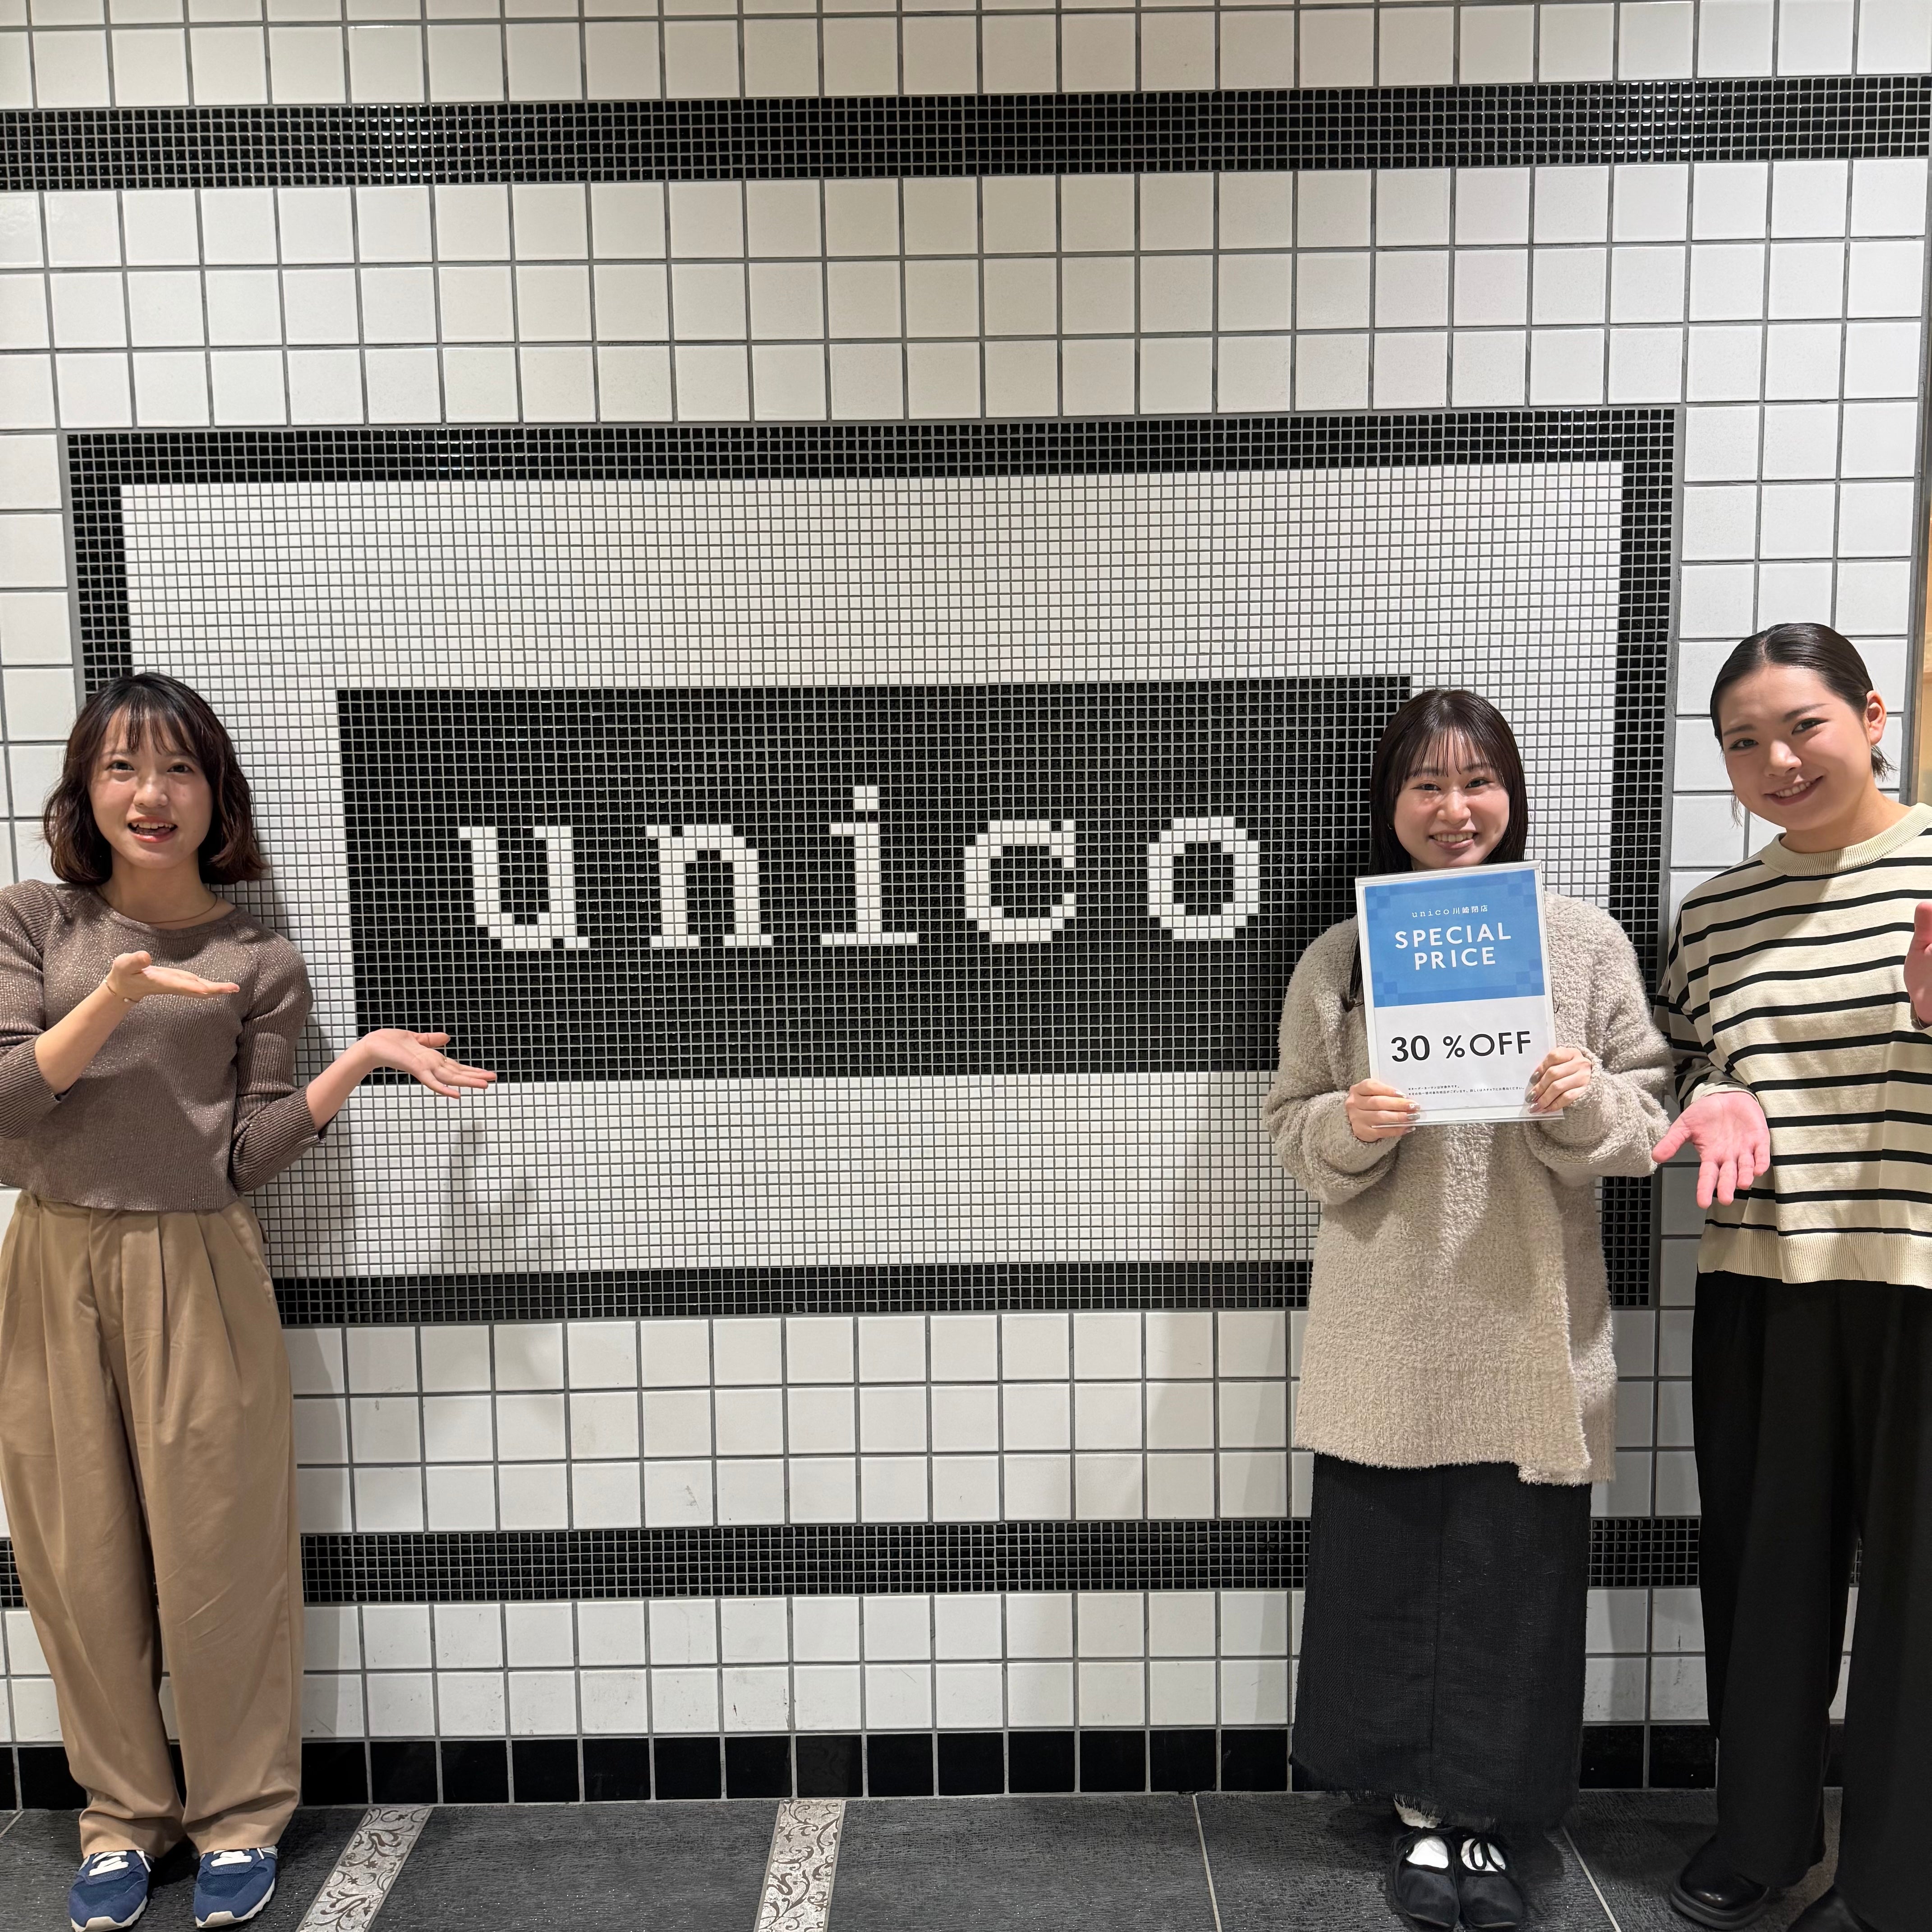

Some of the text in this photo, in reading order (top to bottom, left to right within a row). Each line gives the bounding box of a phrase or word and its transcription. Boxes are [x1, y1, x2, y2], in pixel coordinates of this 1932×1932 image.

[458, 785, 1260, 950] unico
[1395, 922, 1511, 949] SPECIAL
[1414, 947, 1496, 970] PRICE
[1391, 1035, 1430, 1062] 30
